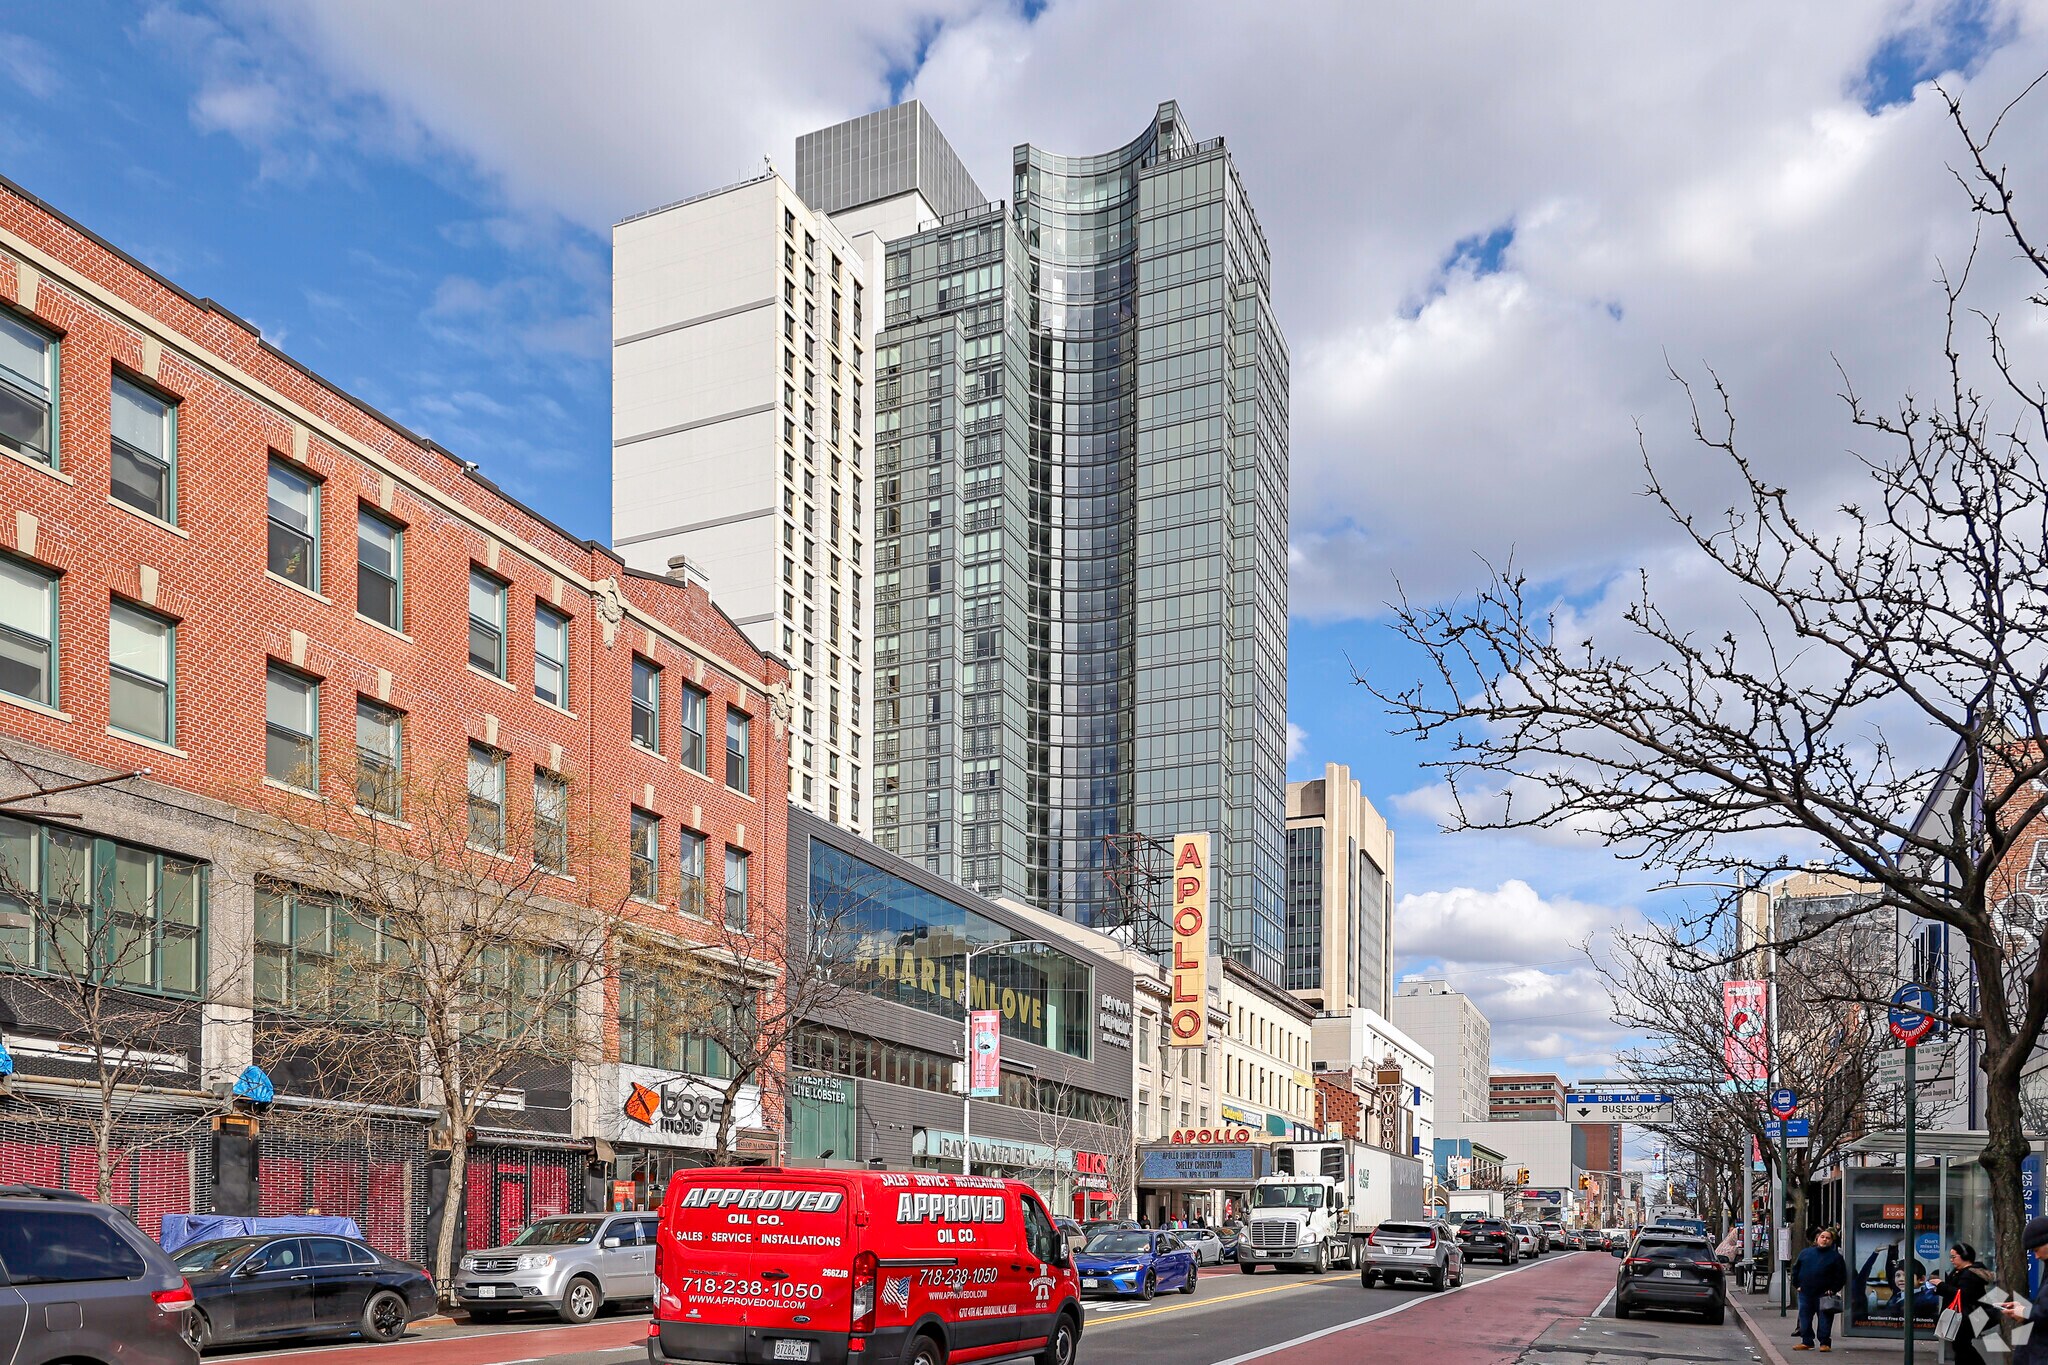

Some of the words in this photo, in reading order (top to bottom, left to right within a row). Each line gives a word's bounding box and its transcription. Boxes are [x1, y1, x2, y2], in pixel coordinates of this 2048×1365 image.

[1172, 842, 1203, 1039] APOLLO
[856, 935, 1041, 1029] #HARLEMLOVE
[1892, 1024, 1900, 1035] NO
[1901, 1019, 1930, 1038] STANDING
[792, 1084, 810, 1097] LIVE
[812, 1088, 846, 1103] LOBSTER
[1602, 1105, 1633, 1114] BUSES
[1636, 1105, 1661, 1114] ONLY
[660, 1118, 704, 1136] mobile
[1171, 1129, 1250, 1145] APOLLO
[989, 1144, 1036, 1166] REPUBLIC
[1175, 1161, 1192, 1170] SHELLY
[1194, 1160, 1222, 1169] CHRISTIAN
[880, 1174, 909, 1186] SALES
[915, 1175, 950, 1187] SERVICE
[953, 1176, 1006, 1189] INSTALLATIONS
[1086, 1176, 1107, 1188] materials
[2022, 1169, 2033, 1187] 125
[681, 1187, 844, 1213] APPROVED
[2023, 1189, 2033, 1201] St
[896, 1192, 1006, 1223] APPROVED
[727, 1213, 752, 1225] OIL
[756, 1214, 784, 1226] CO.
[676, 1231, 703, 1241] SALES
[711, 1232, 752, 1243] SERVICE
[761, 1234, 841, 1247] INSTALLATIONS
[937, 1229, 956, 1243] OIL
[958, 1229, 976, 1243] CO.
[688, 1295, 807, 1309] WWW.APPROVEDOIL.COM
[928, 1290, 988, 1300] WWW.APPROVEDOIL.COM
